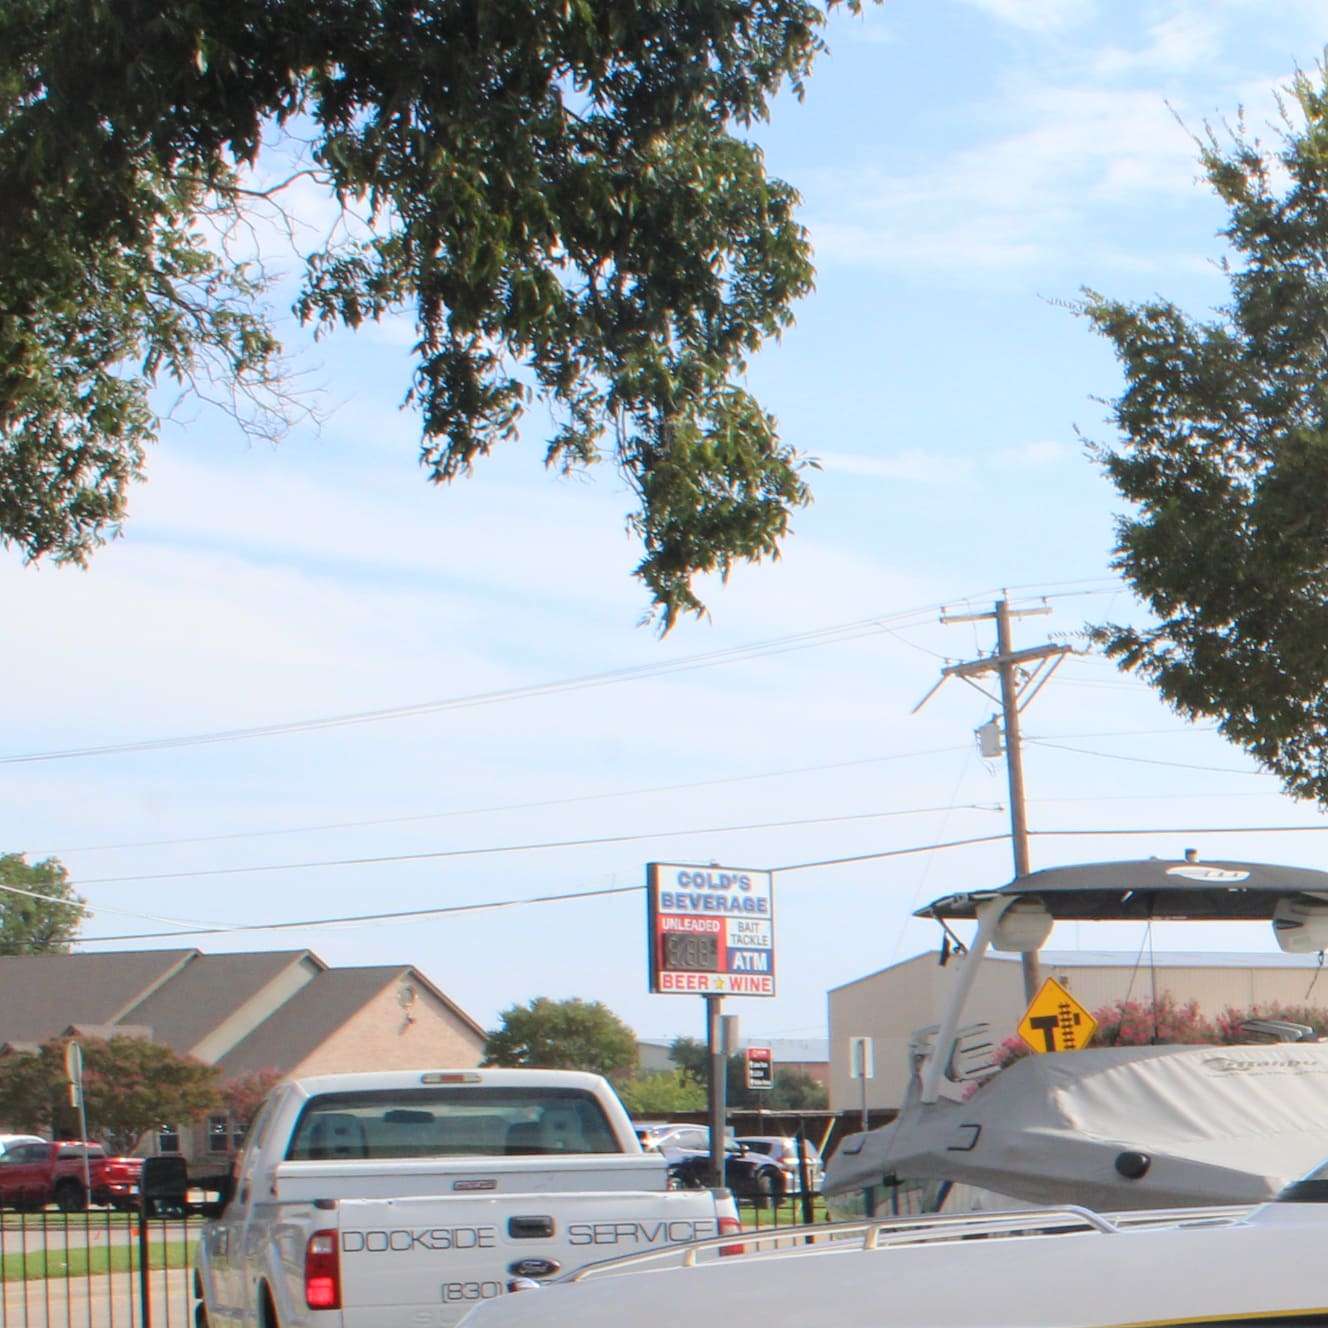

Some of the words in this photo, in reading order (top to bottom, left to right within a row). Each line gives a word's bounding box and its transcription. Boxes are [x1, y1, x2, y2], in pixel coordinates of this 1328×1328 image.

[677, 870, 751, 892] COLD'S
[661, 891, 768, 914] BEVERAGE
[662, 917, 721, 933] UNLEADED
[737, 920, 760, 934] BAIT
[731, 933, 769, 947] TACKLE
[733, 951, 768, 972] ATM
[662, 974, 709, 990] BEER
[729, 975, 772, 993] WINE
[342, 1226, 496, 1253] DOCKSIDE
